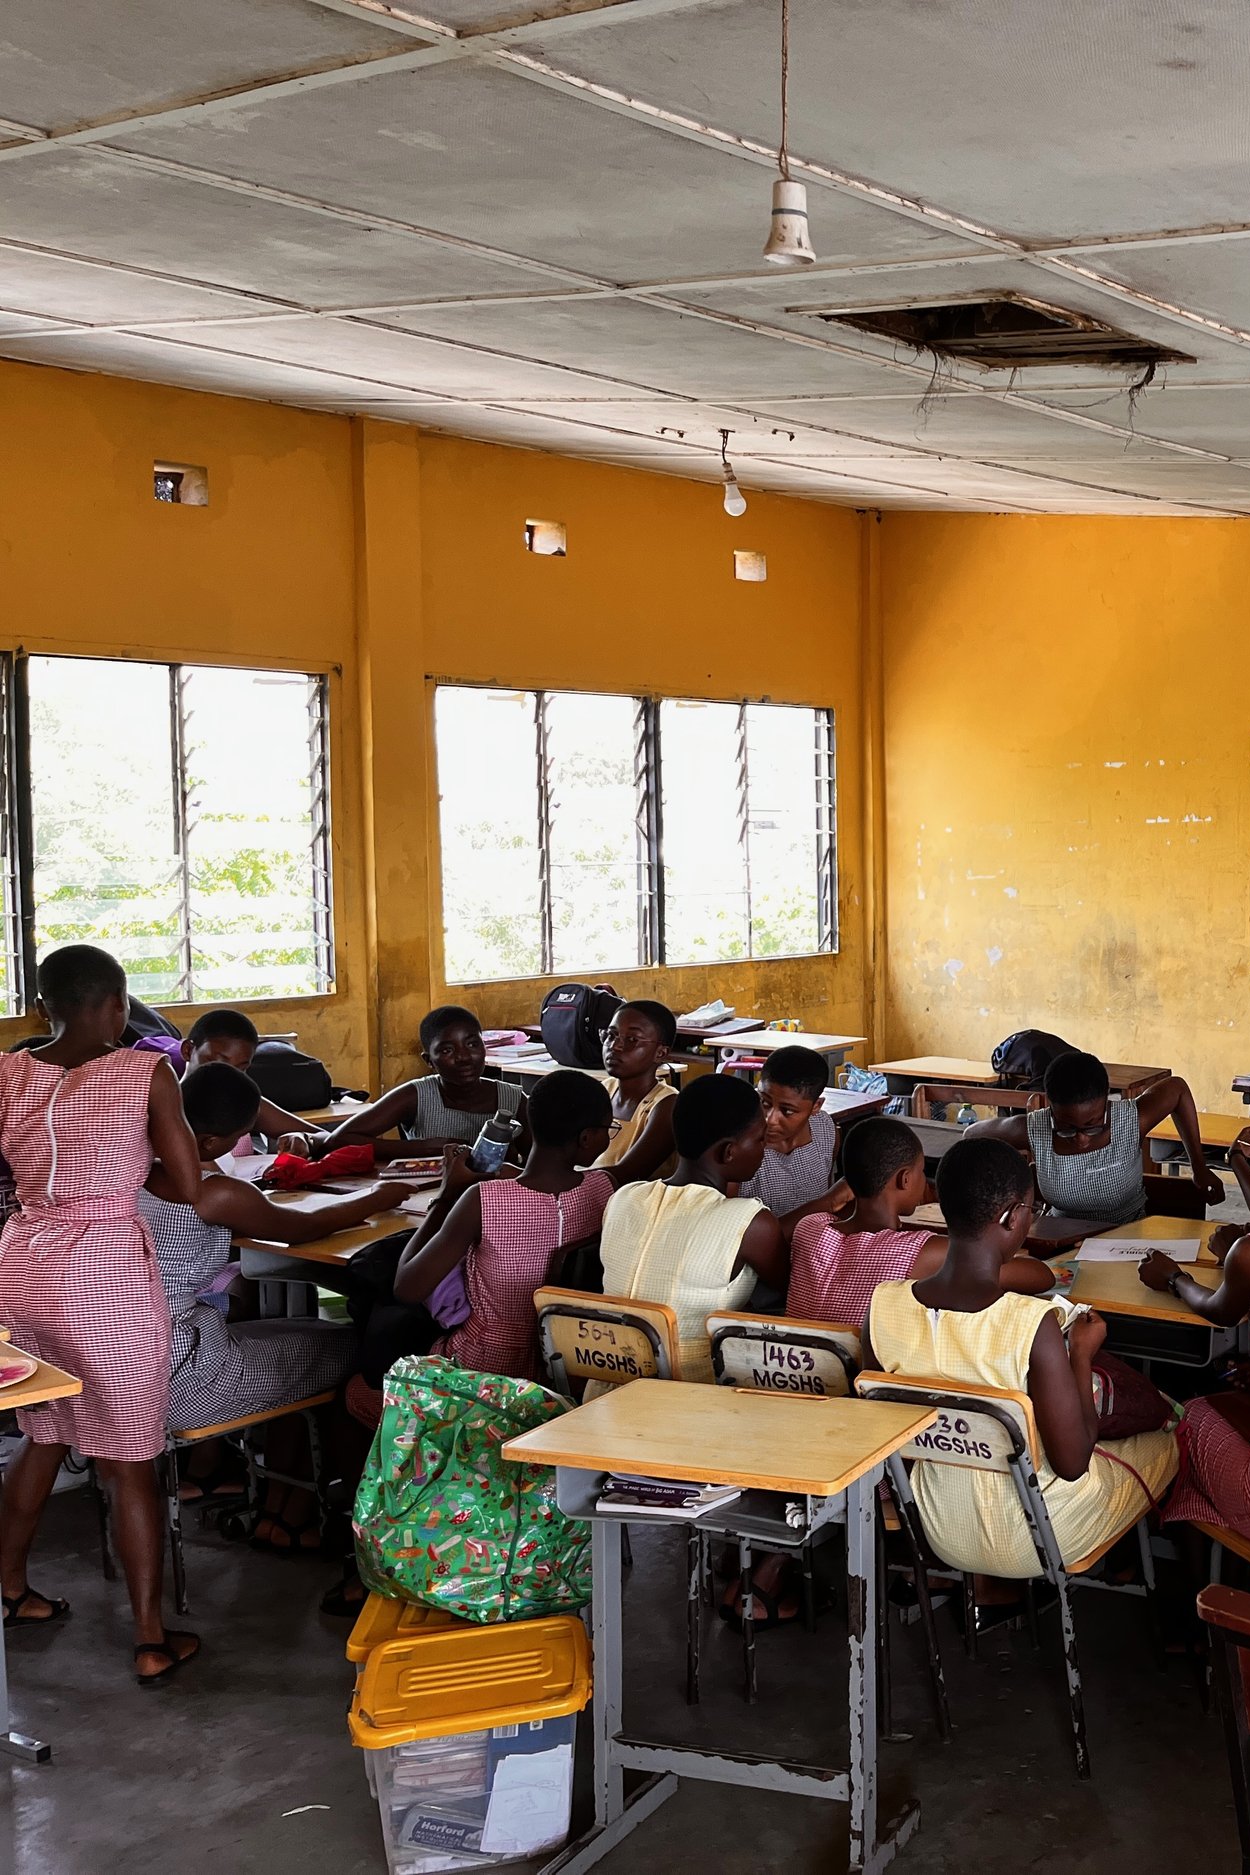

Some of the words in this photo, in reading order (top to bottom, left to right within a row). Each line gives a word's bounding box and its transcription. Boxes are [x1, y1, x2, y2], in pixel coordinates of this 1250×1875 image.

[763, 1341, 815, 1372] 1463
[753, 1368, 825, 1395] MGSHS
[915, 1432, 992, 1460] MGSHS
